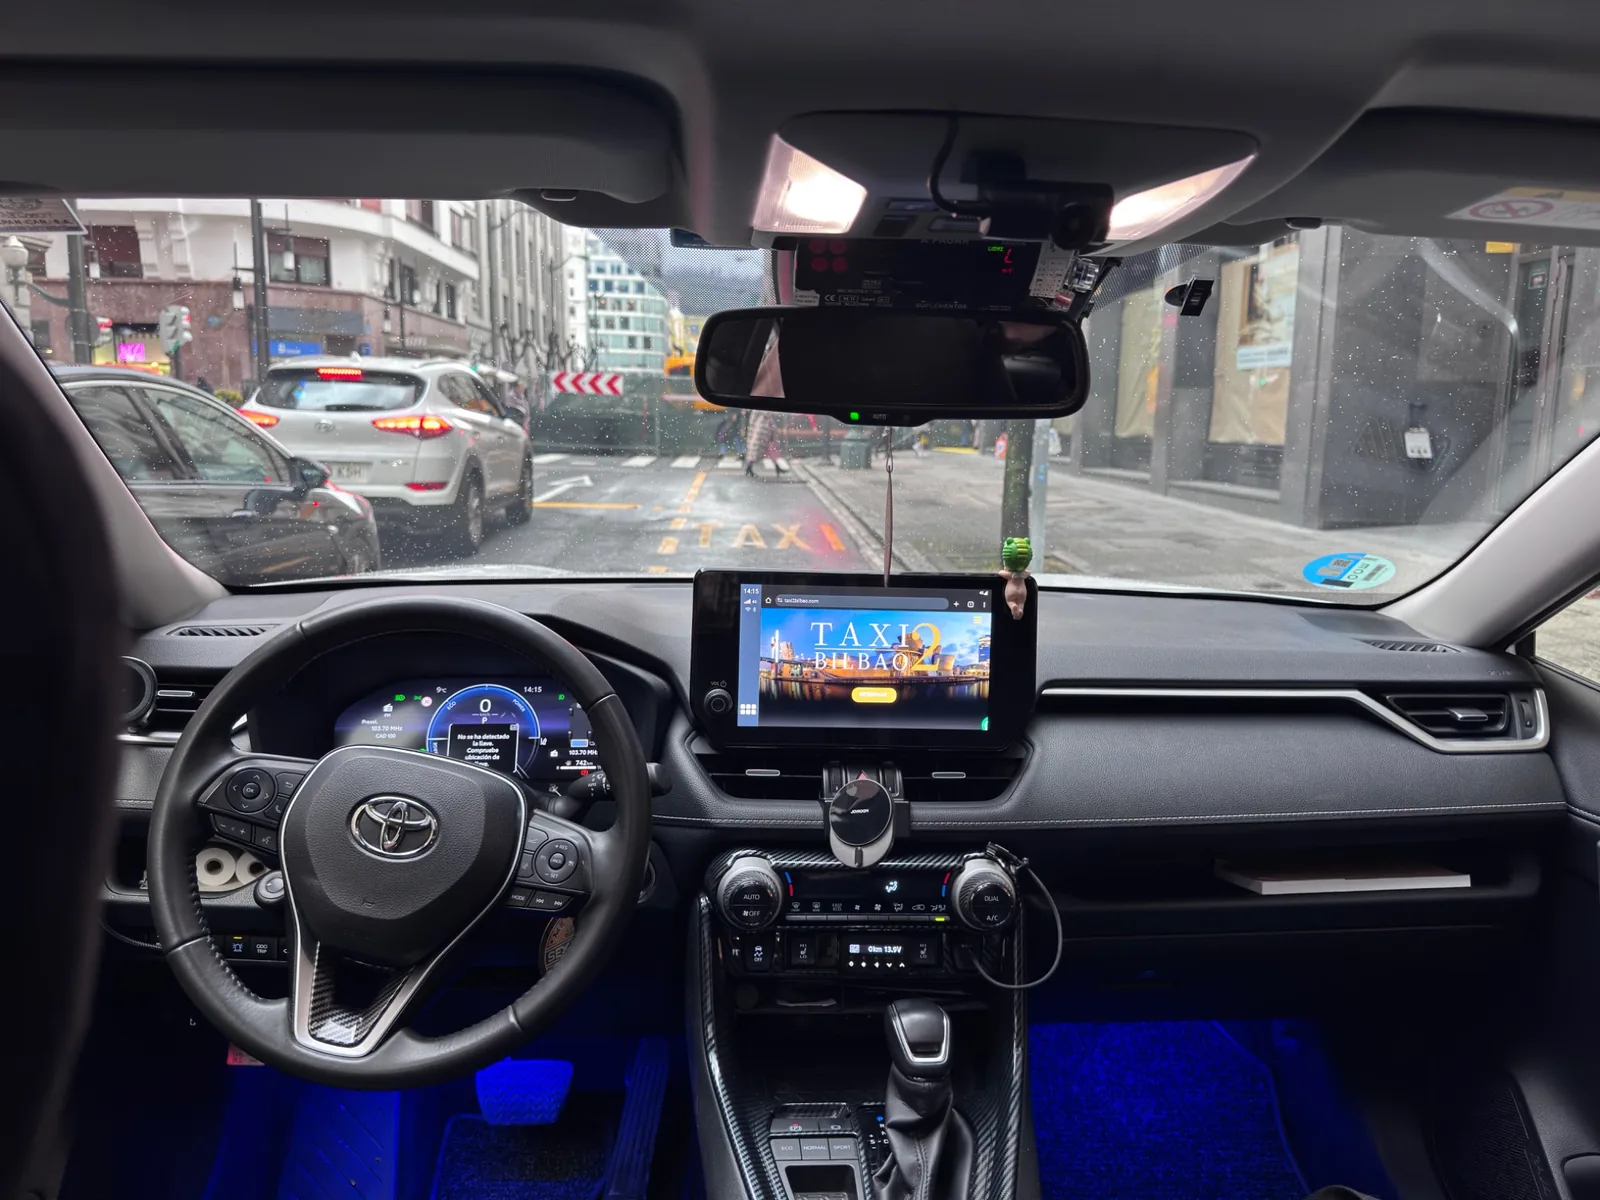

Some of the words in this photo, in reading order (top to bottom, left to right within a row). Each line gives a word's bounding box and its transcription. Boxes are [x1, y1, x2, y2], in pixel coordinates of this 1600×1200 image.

[915, 302, 967, 310] SUPLEMENTOS
[691, 522, 846, 551] TAXI
[810, 621, 910, 649] TAXI
[911, 623, 940, 672] 2
[814, 651, 909, 671] BILBAO
[447, 701, 457, 711] ECO
[479, 698, 491, 713] 0
[512, 698, 526, 713] POWER
[481, 716, 488, 725] P
[511, 893, 526, 901] MODE
[743, 893, 761, 901] AUTO
[748, 909, 761, 917] OFF
[986, 914, 999, 922] A/C
[883, 945, 903, 954] 13.9V
